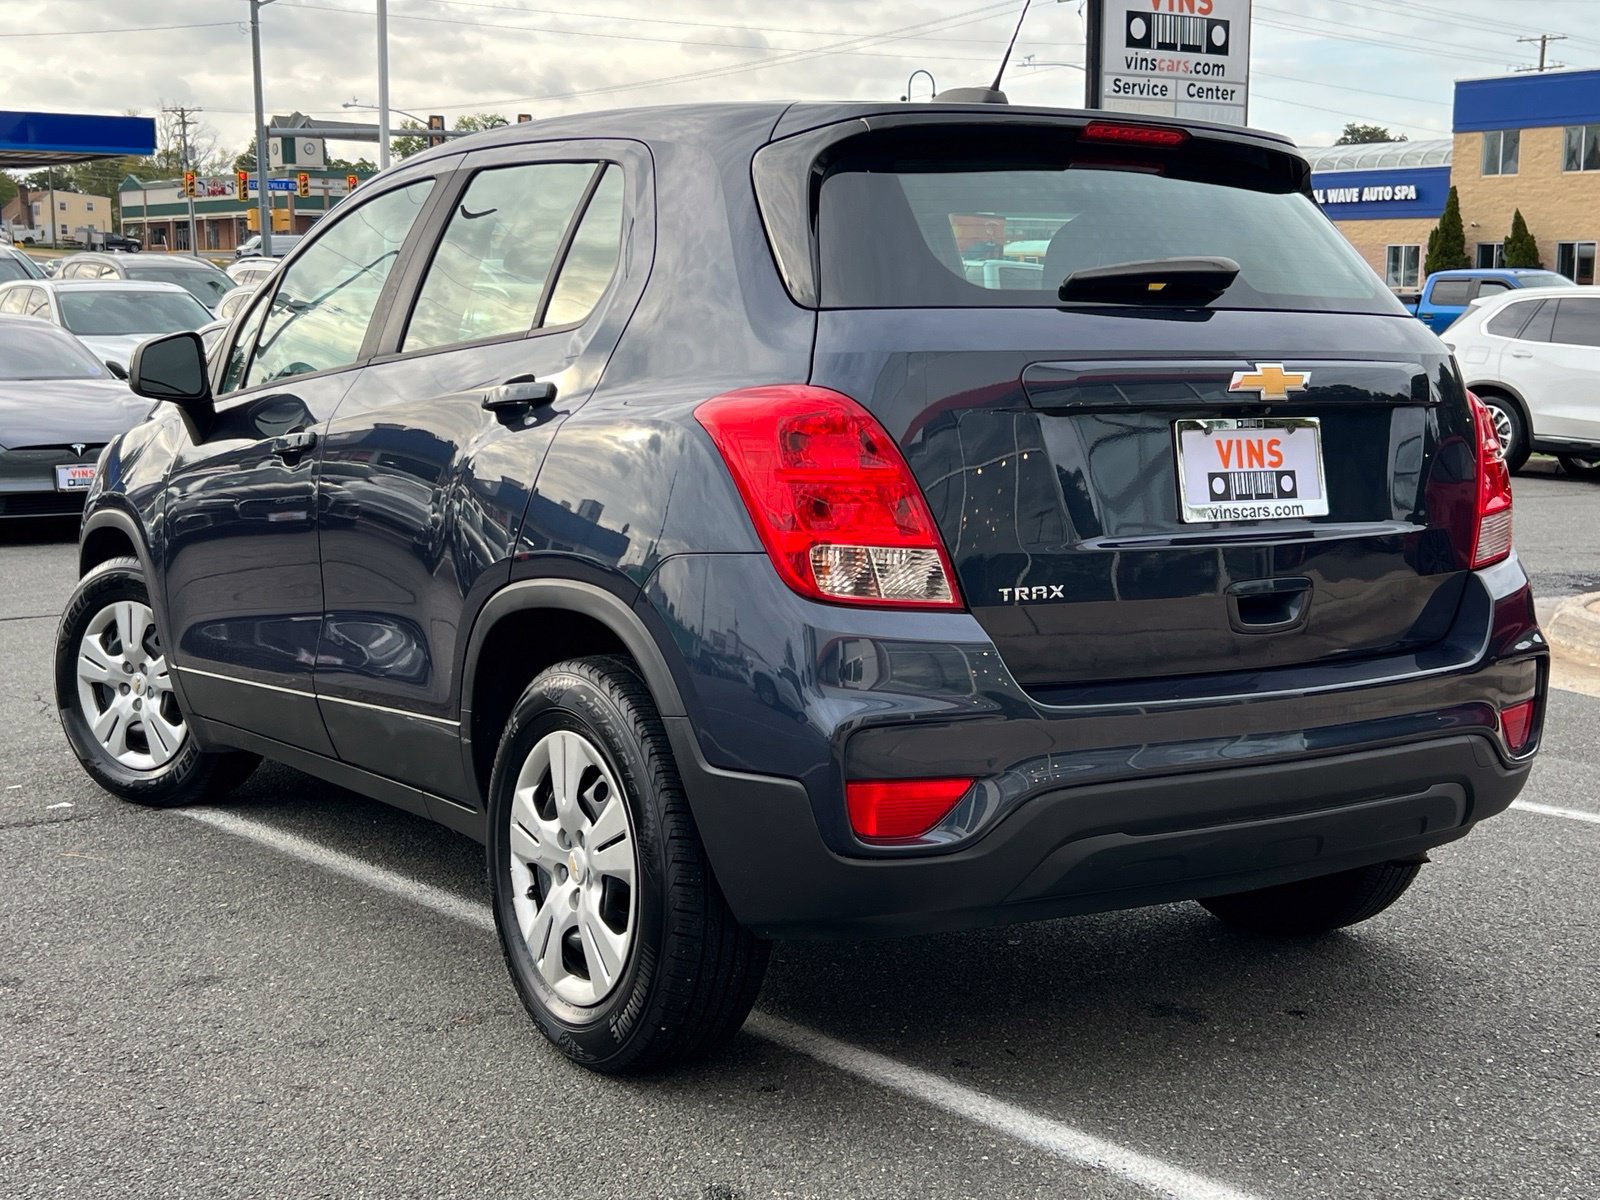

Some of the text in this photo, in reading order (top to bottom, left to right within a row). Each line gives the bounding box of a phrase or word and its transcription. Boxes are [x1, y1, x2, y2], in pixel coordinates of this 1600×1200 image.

[1125, 53, 1225, 77] vinscars.com
[1113, 78, 1235, 101] Service Center
[1327, 188, 1360, 204] WAVE
[1362, 185, 1393, 202] AUTO
[1394, 185, 1417, 200] SPA
[1215, 438, 1284, 469] VINS
[71, 469, 96, 478] VINS
[1209, 504, 1305, 520] vinscars.com
[998, 584, 1065, 602] TRAX
